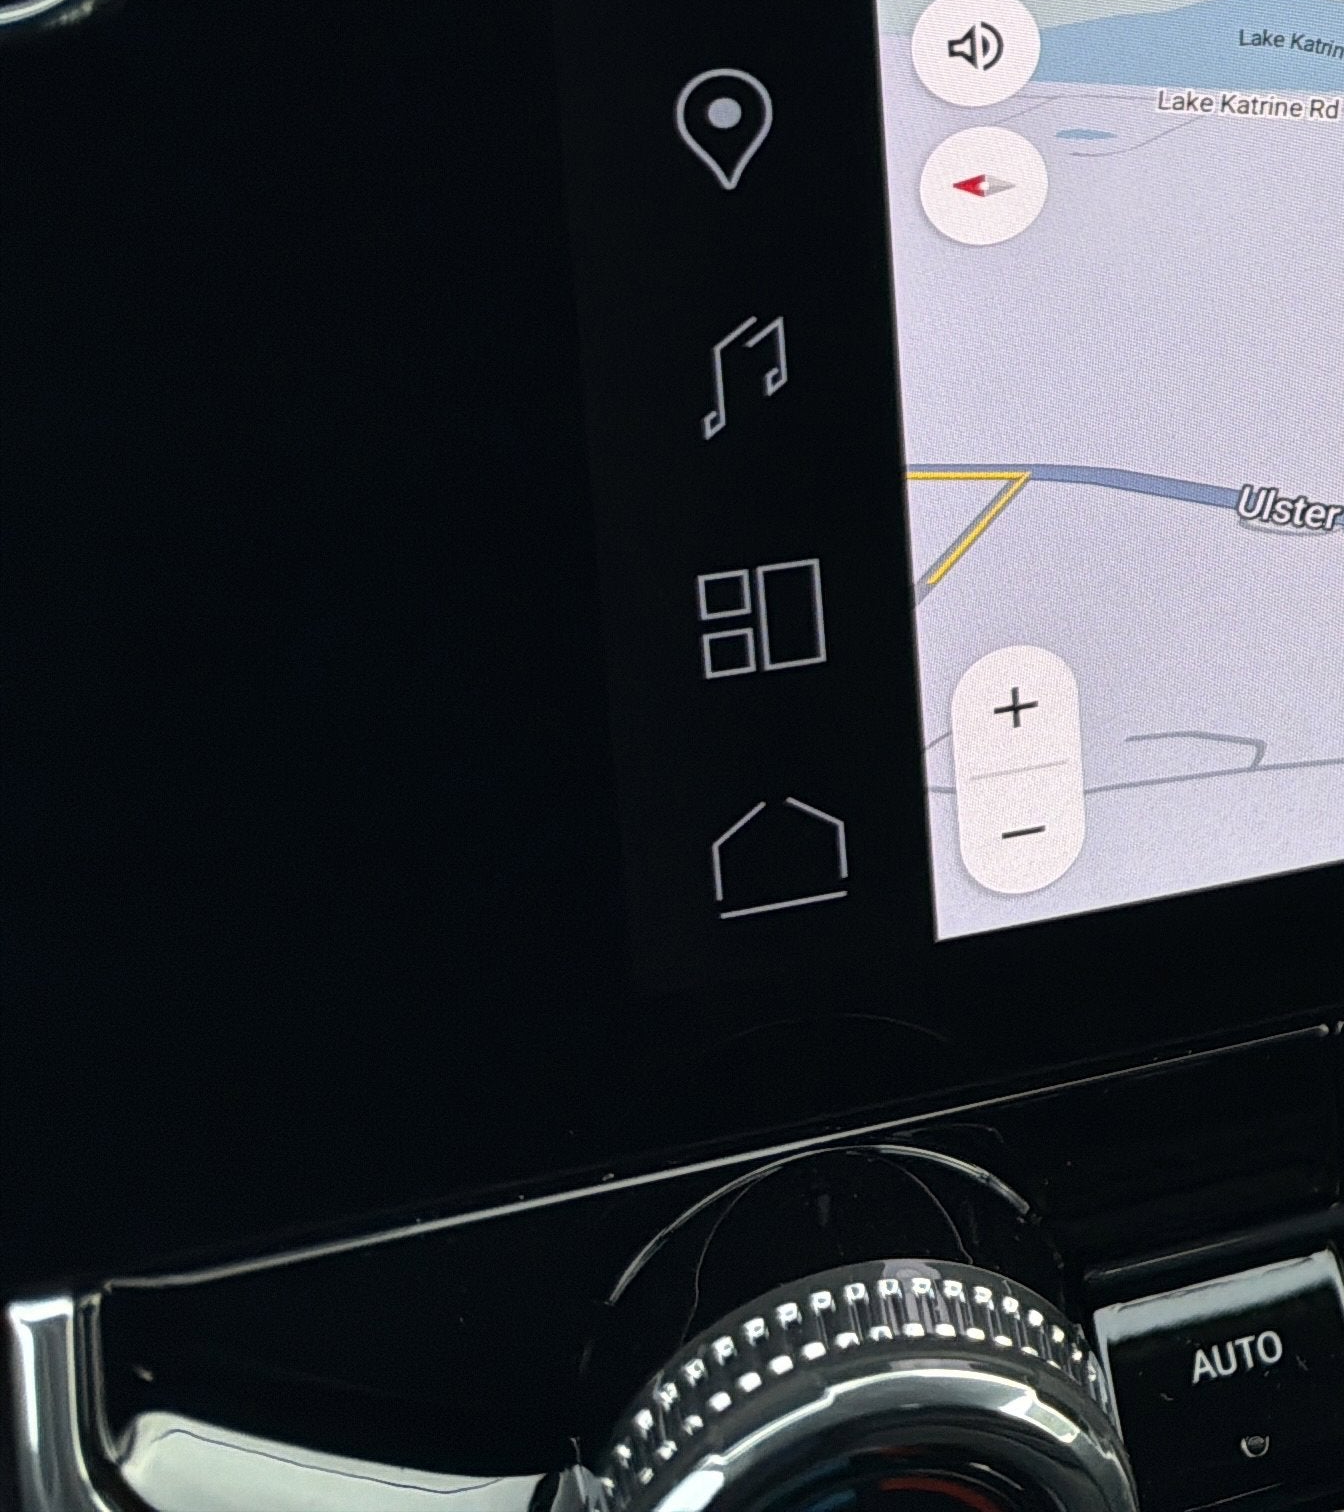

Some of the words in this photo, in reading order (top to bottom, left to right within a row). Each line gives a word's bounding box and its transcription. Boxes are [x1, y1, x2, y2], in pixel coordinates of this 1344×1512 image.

[1238, 28, 1286, 48] Lake
[1157, 90, 1214, 113] Lake
[1220, 94, 1302, 118] Katrine
[1309, 99, 1341, 120] Rd
[1236, 484, 1343, 531] Ulster
[1191, 1330, 1284, 1385] AUTO
